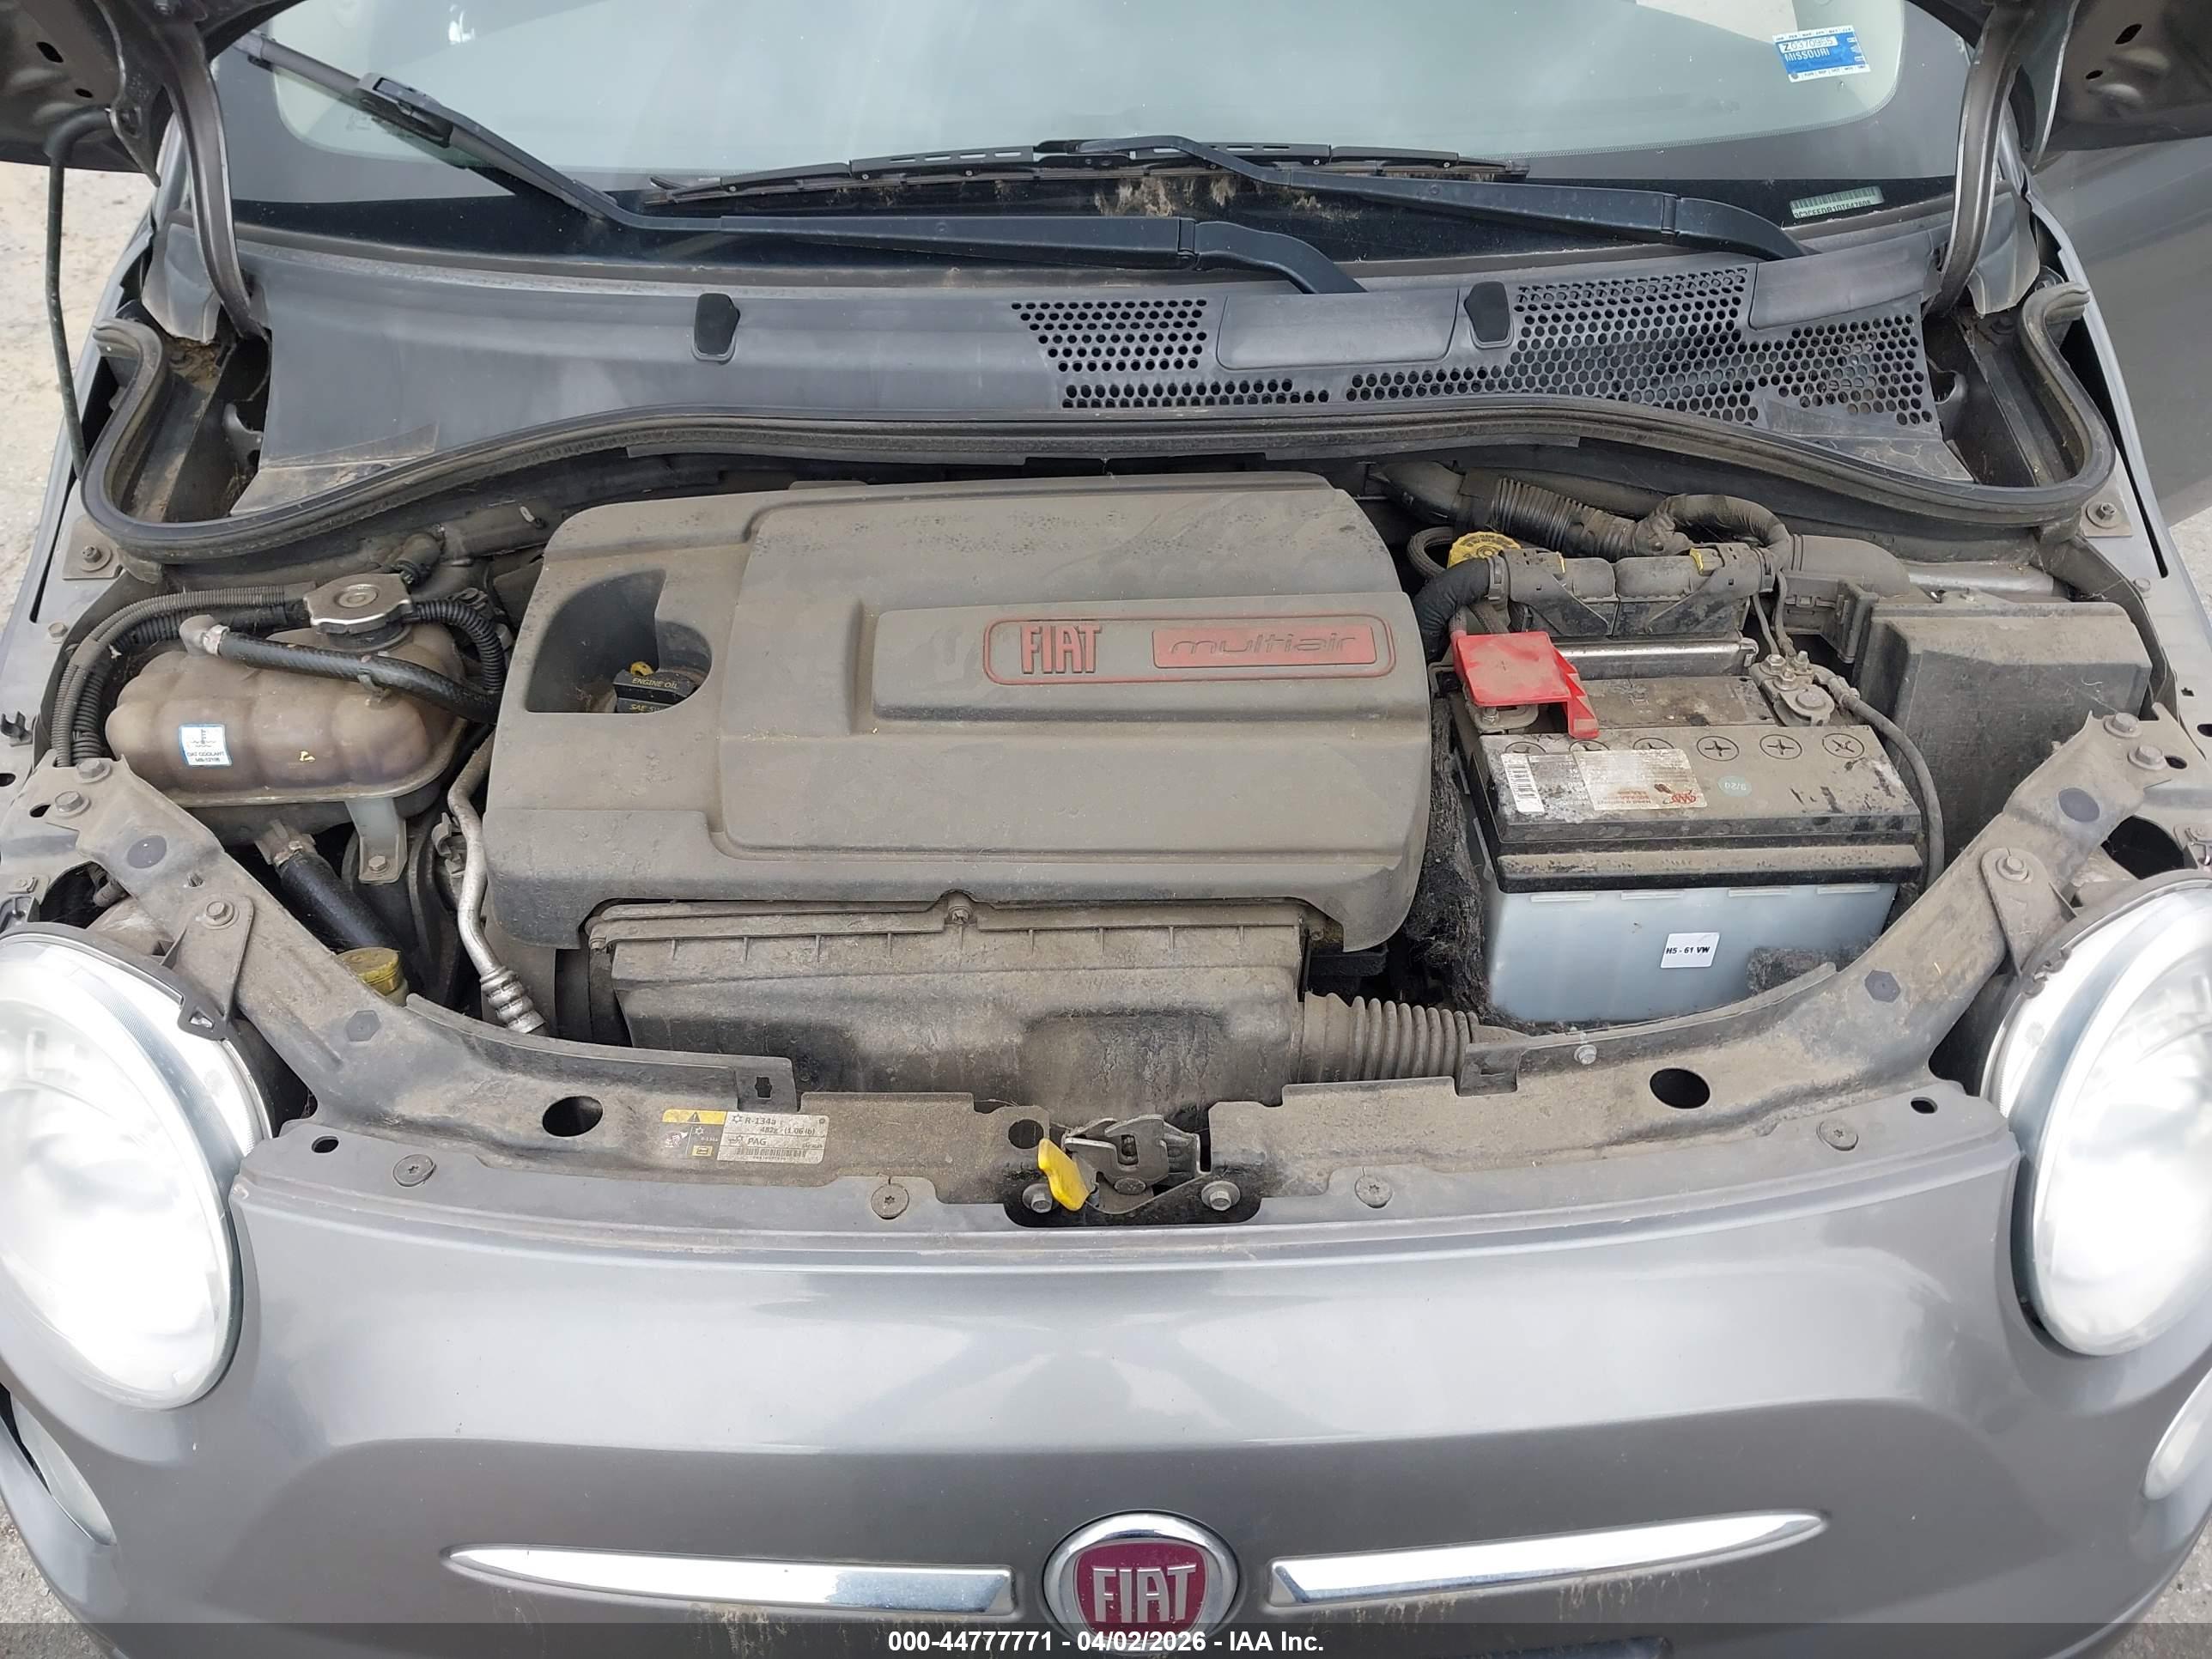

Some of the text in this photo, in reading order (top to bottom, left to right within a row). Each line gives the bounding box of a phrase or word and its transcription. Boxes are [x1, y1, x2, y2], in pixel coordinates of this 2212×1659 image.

[1784, 47, 1831, 63] MISSOURI
[1021, 624, 1102, 674] FIAT
[1170, 633, 1357, 654] multiair
[632, 678, 679, 689] ENGINE OIL
[744, 1117, 776, 1126] R-134a
[805, 1127, 815, 1135] lb)
[1091, 1564, 1197, 1624] FIAT
